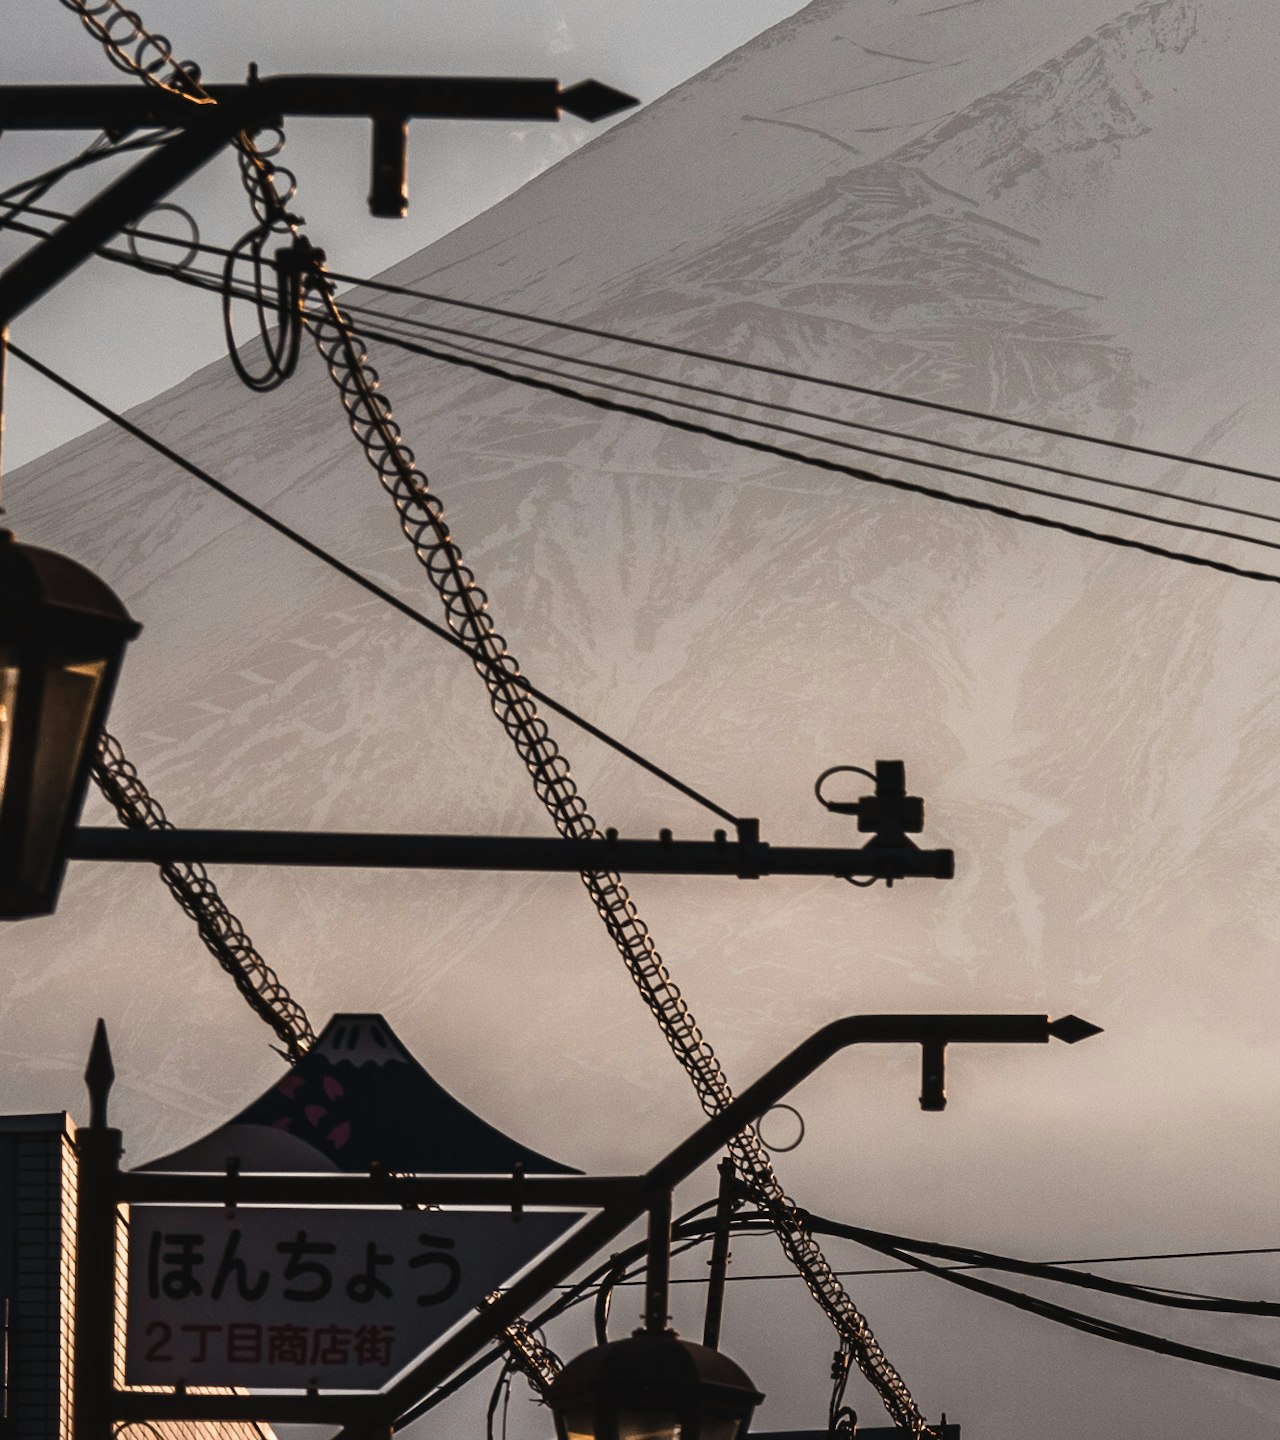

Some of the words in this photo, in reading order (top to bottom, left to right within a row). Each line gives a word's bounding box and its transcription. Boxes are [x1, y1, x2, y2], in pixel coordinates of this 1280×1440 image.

[147, 1229, 462, 1307] ほんちょう
[146, 1321, 393, 1367] 2丁目商店街
